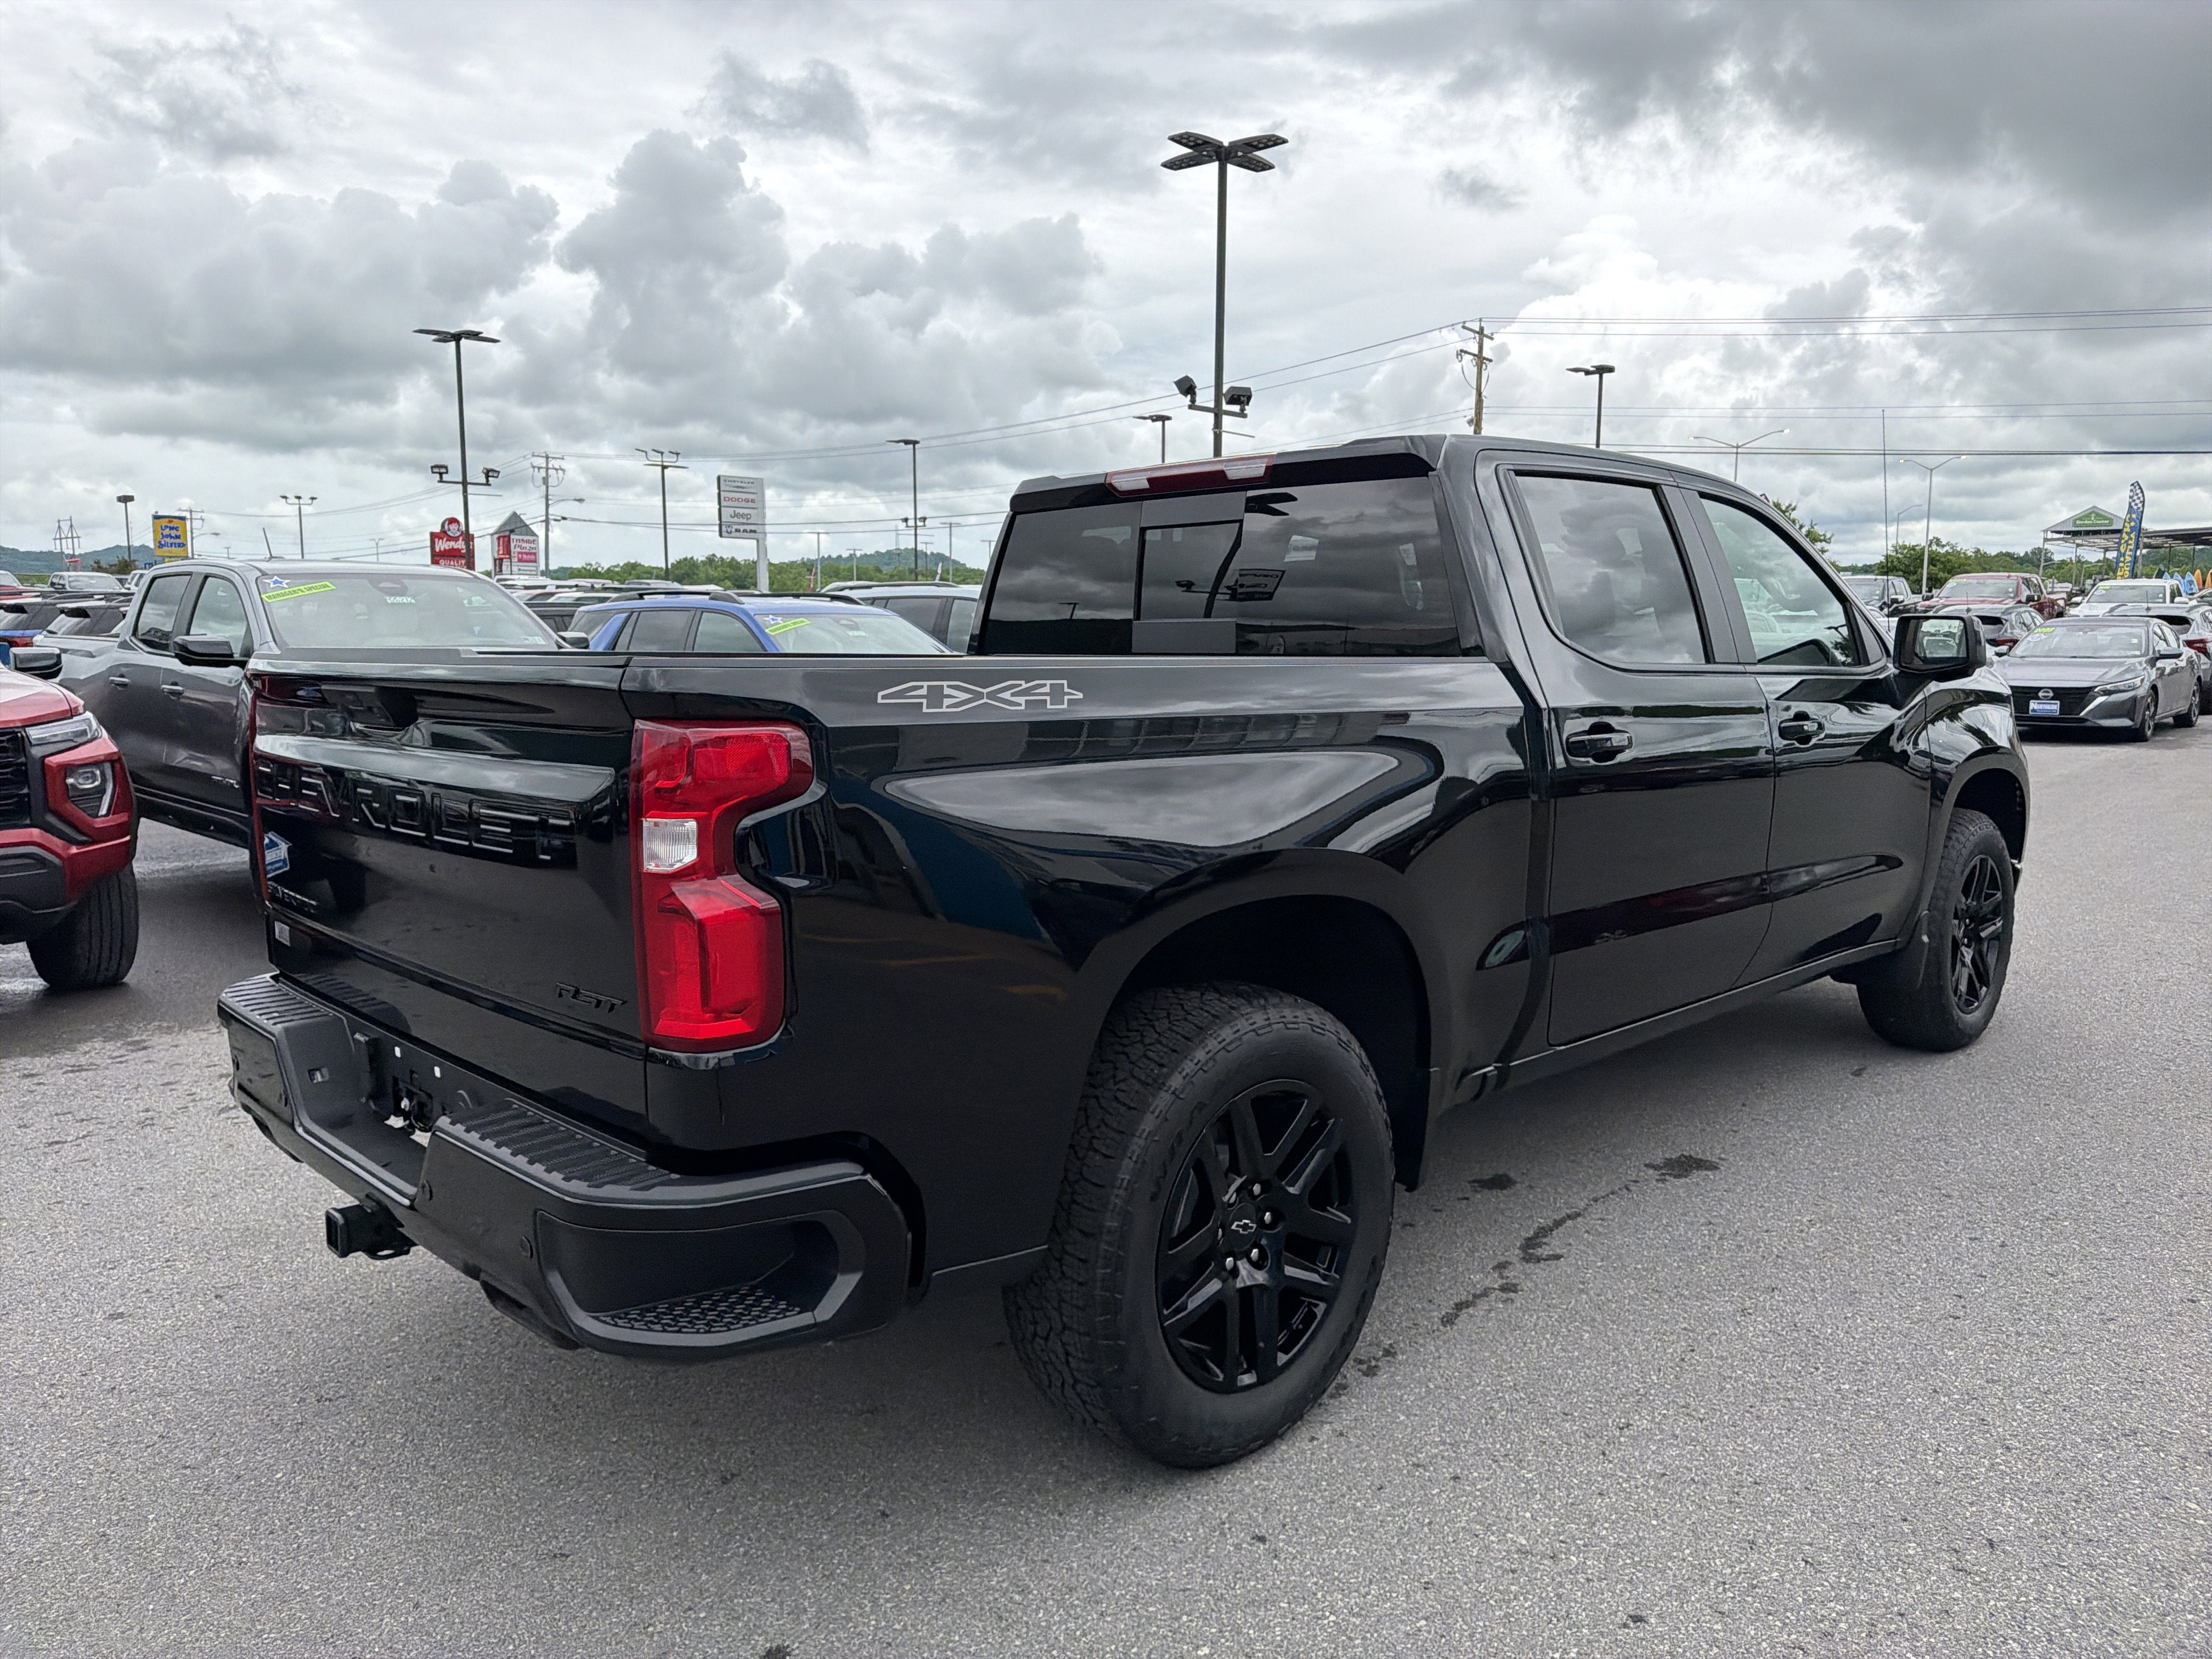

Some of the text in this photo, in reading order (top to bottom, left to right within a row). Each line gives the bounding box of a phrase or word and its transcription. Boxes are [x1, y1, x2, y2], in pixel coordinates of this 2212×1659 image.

[730, 510, 752, 521] Jeep
[439, 558, 466, 567] QUALIT
[555, 981, 628, 1013] RST
